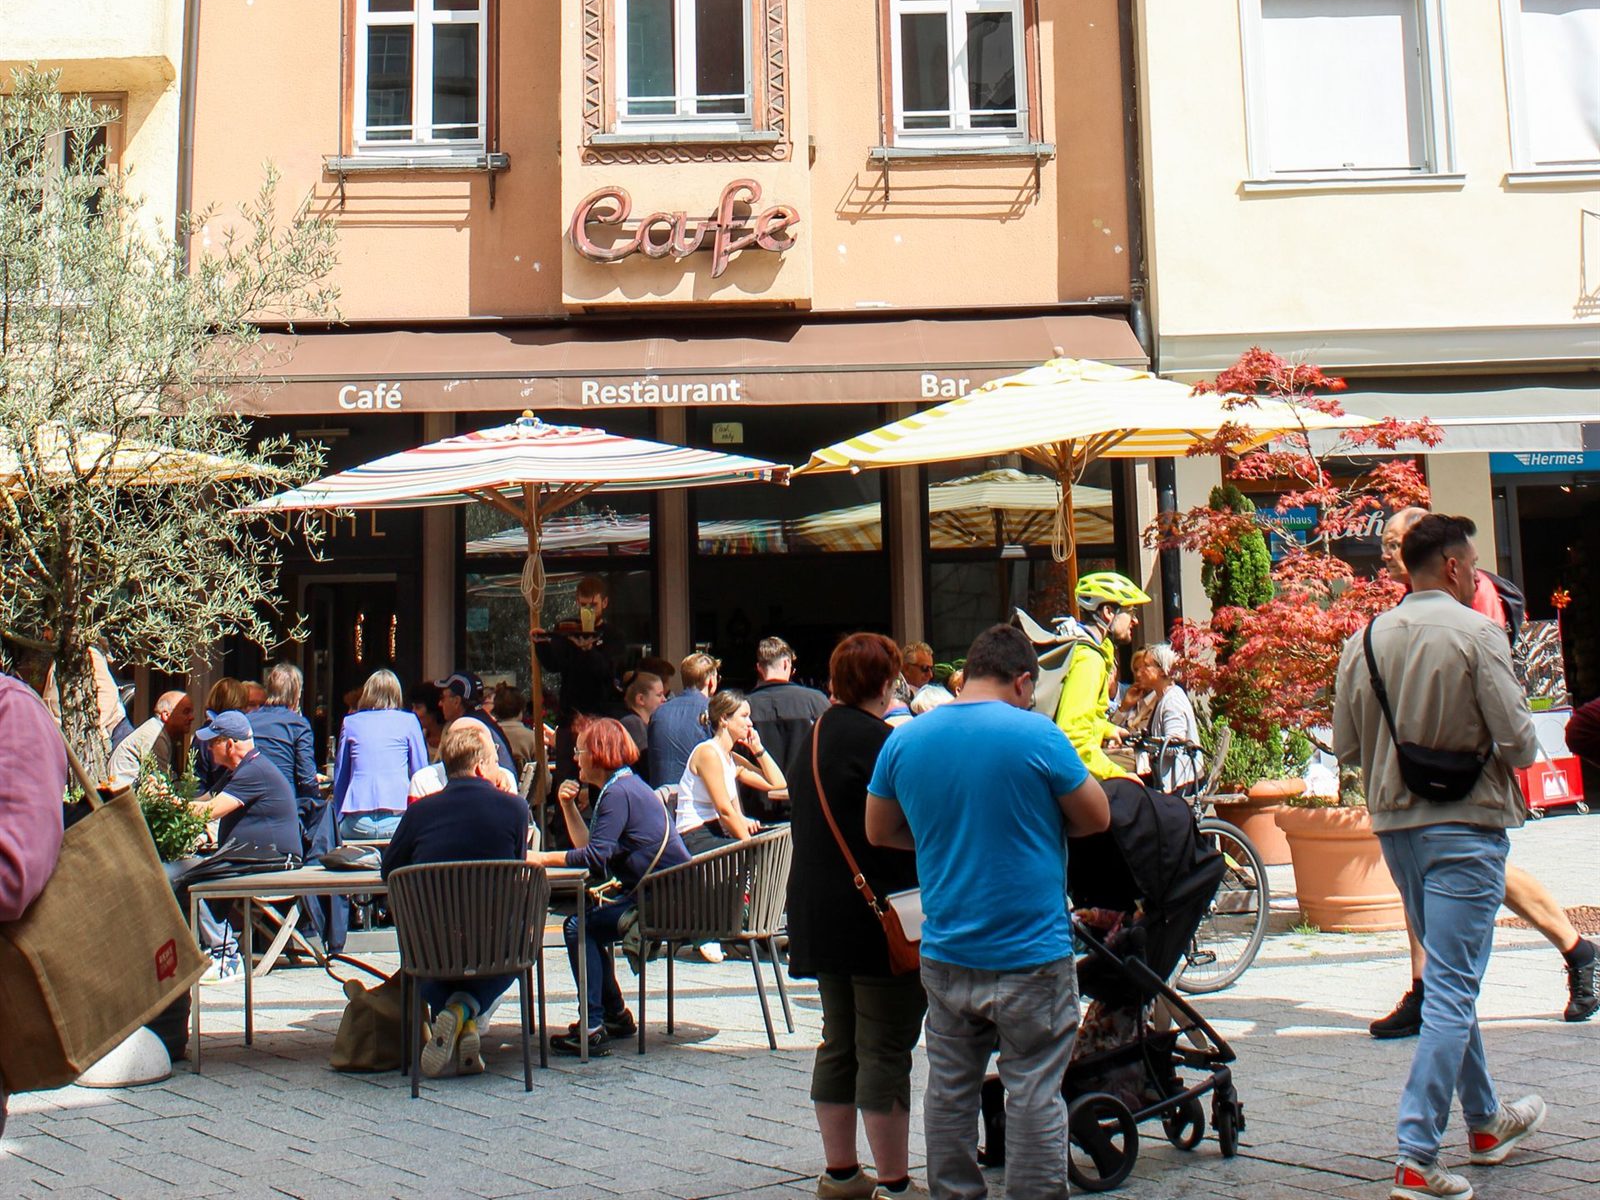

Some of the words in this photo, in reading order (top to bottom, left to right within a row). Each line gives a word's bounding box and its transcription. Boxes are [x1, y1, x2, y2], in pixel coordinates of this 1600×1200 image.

[338, 382, 402, 409] Café
[581, 379, 741, 405] Restaurant
[921, 374, 970, 398] Bar
[1531, 453, 1584, 465] Hermes
[1255, 513, 1312, 525] Rformhaus
